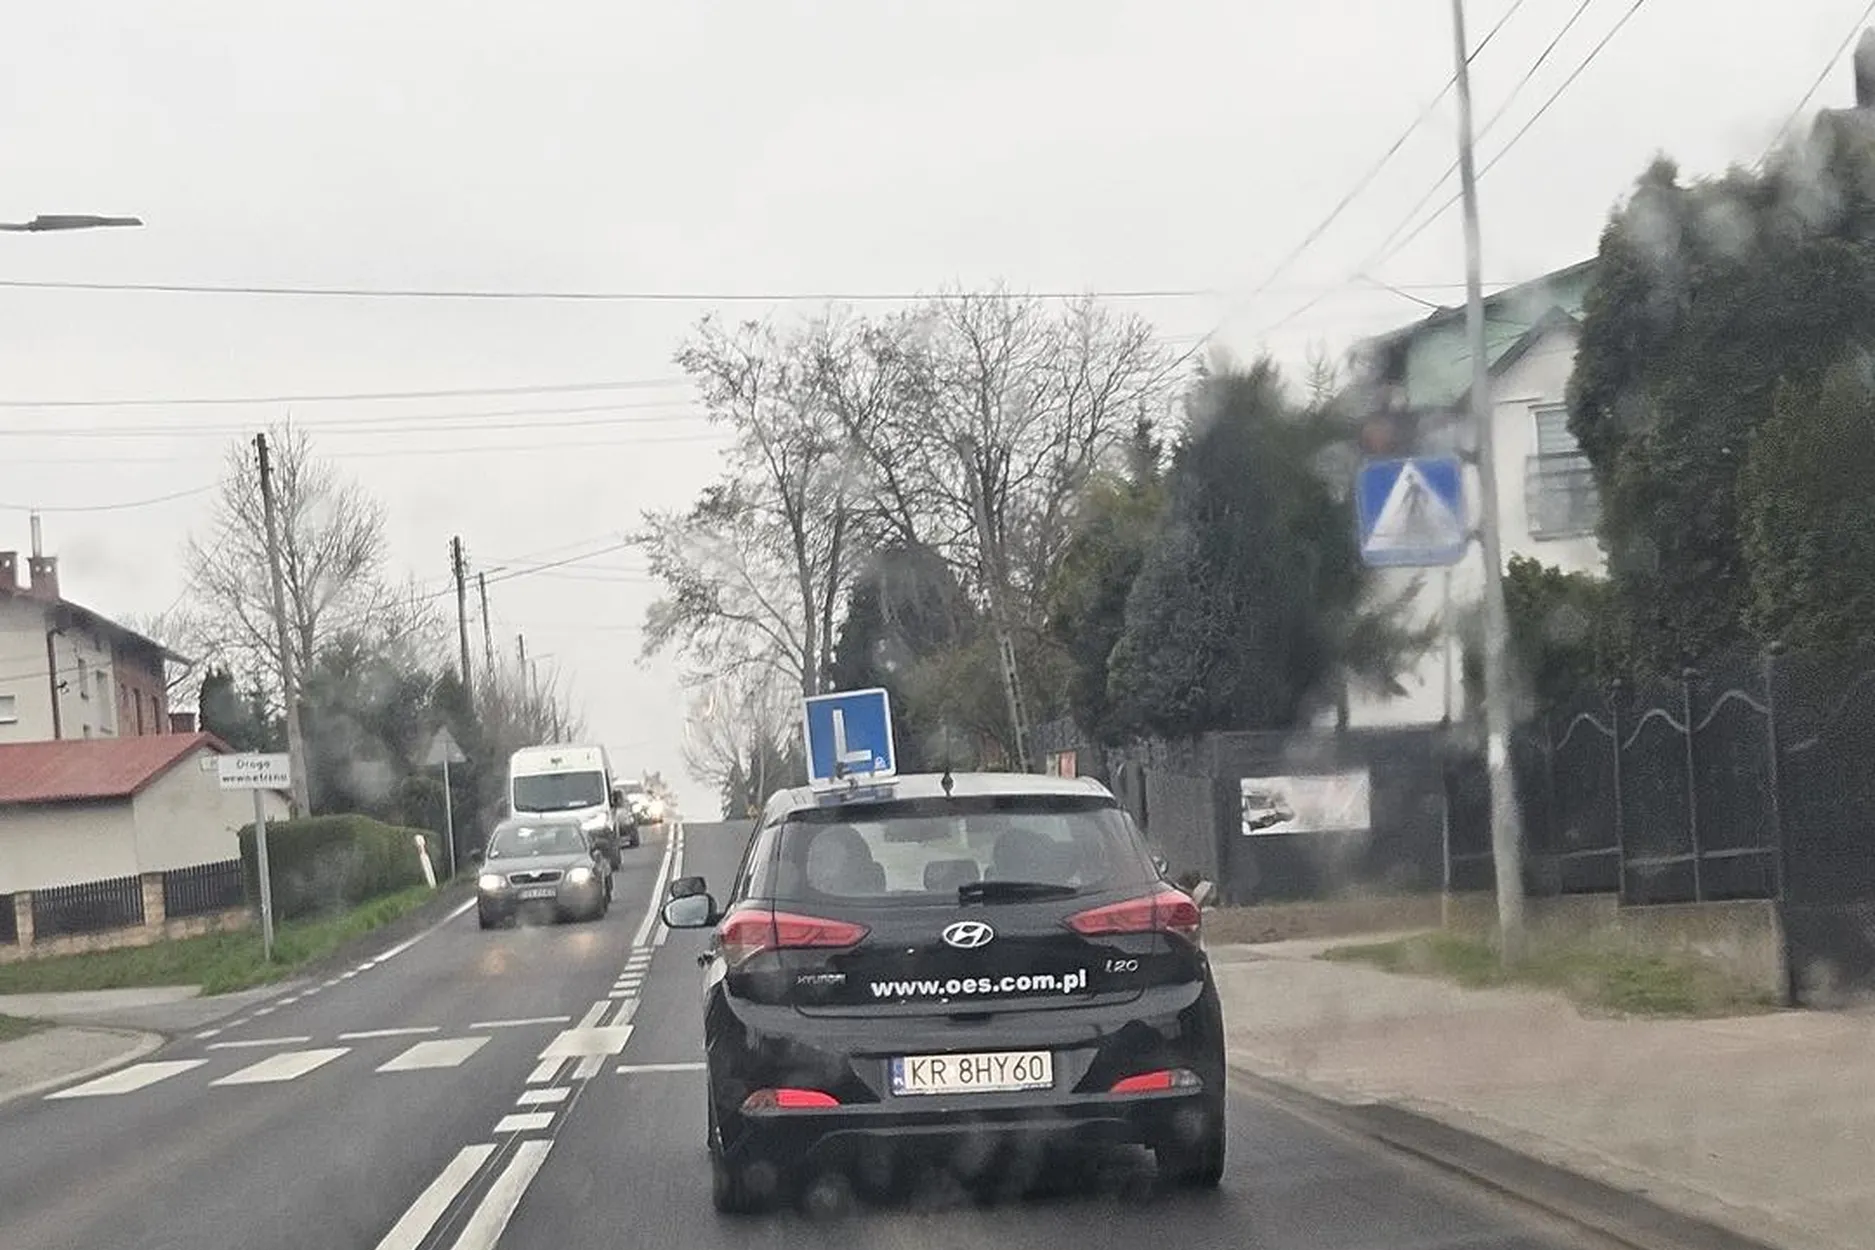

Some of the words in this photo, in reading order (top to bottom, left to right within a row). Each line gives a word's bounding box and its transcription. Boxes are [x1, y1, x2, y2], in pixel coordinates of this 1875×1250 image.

[832, 709, 872, 763] L
[870, 968, 1087, 998] www.oes.com.pl
[911, 1058, 947, 1086] KR
[959, 1054, 1045, 1084] 8HY60
